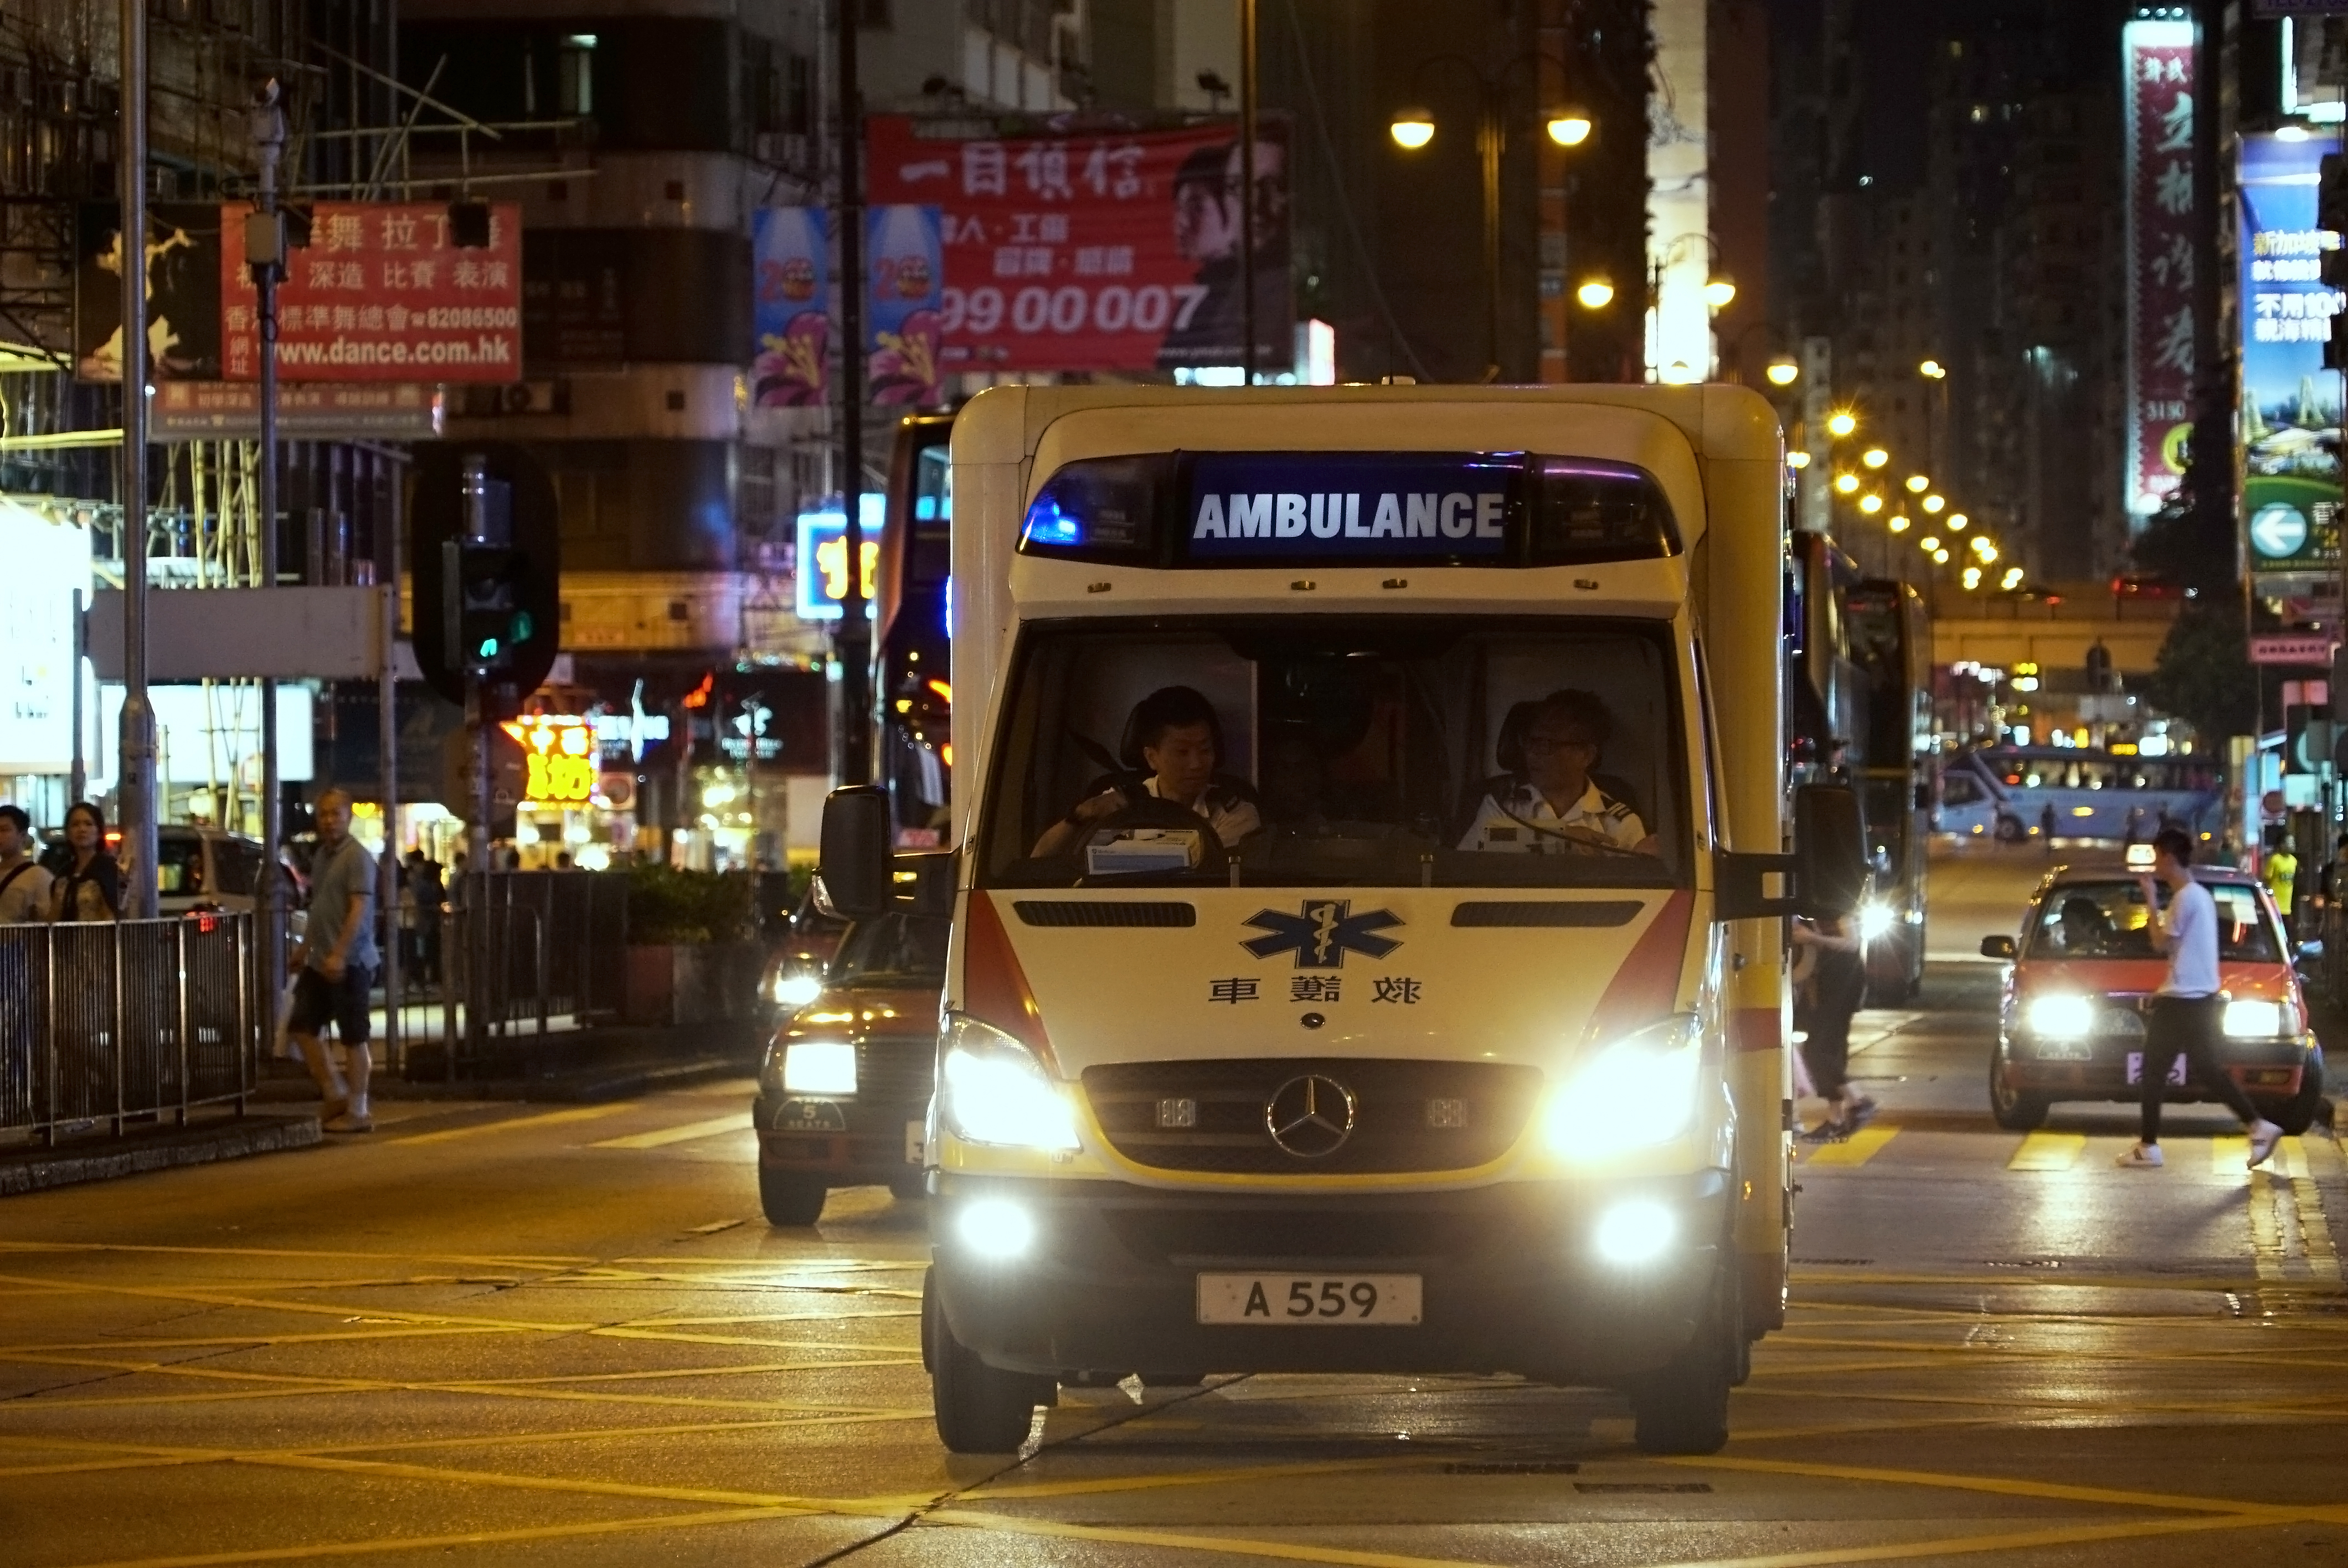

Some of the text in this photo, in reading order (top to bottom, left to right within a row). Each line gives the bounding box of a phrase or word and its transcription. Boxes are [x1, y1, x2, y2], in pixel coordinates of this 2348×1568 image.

[1193, 492, 1505, 539] AMBULANCE
[1243, 1281, 1378, 1318] A 559
